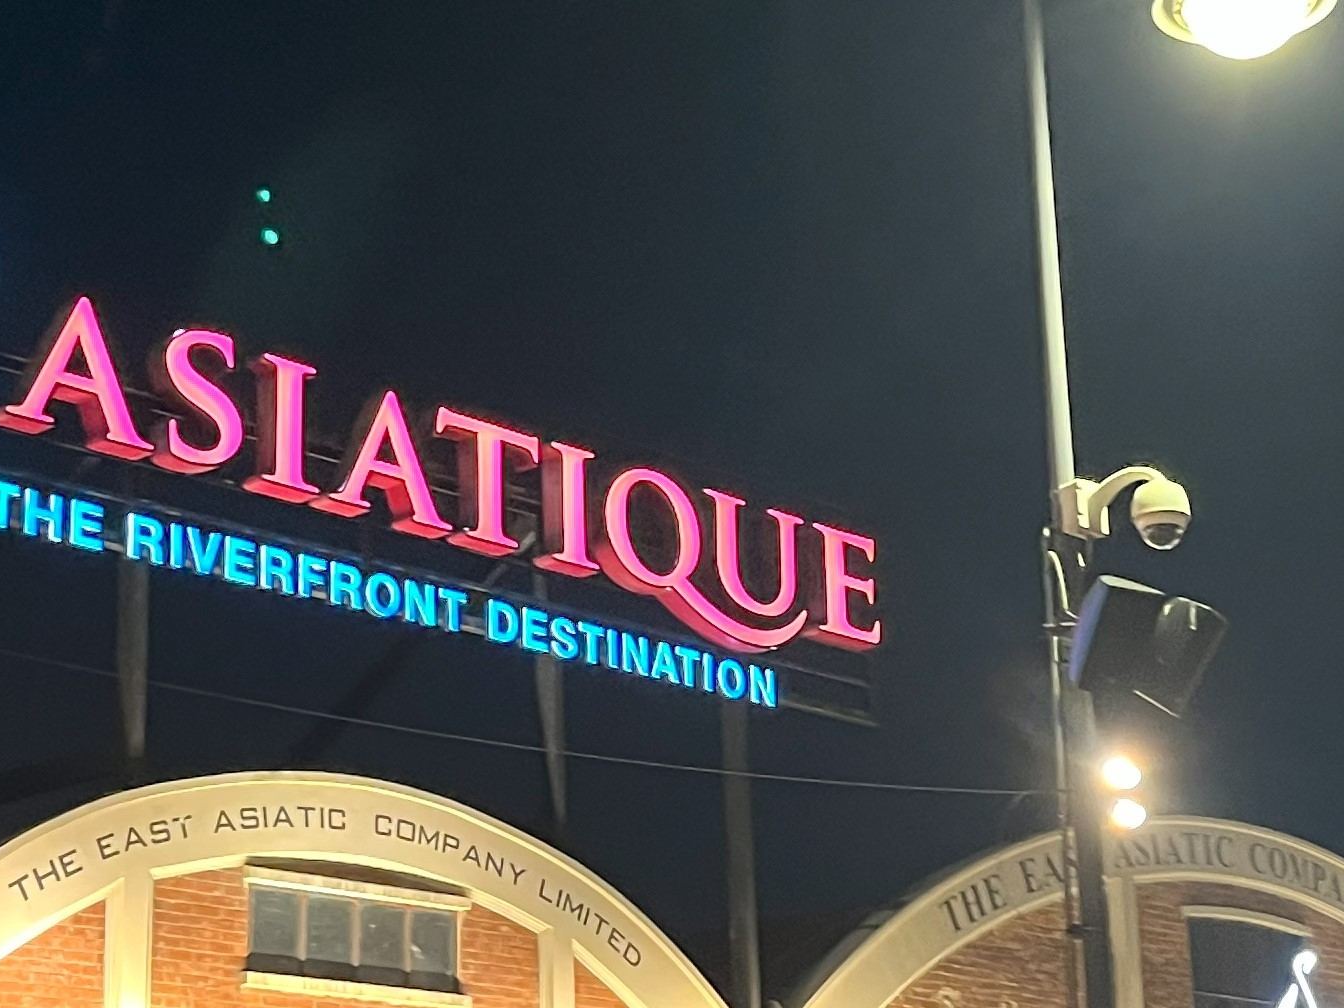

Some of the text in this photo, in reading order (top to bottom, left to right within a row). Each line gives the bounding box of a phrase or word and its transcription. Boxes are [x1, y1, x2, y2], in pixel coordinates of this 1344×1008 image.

[125, 512, 467, 633] RIVERFRONT
[485, 599, 779, 708] DESTINATION
[7, 805, 642, 969] THE EAST ASIATIC COMPANY LIMITED
[940, 873, 1008, 932] THE
[1115, 832, 1234, 869] ASIATIC
